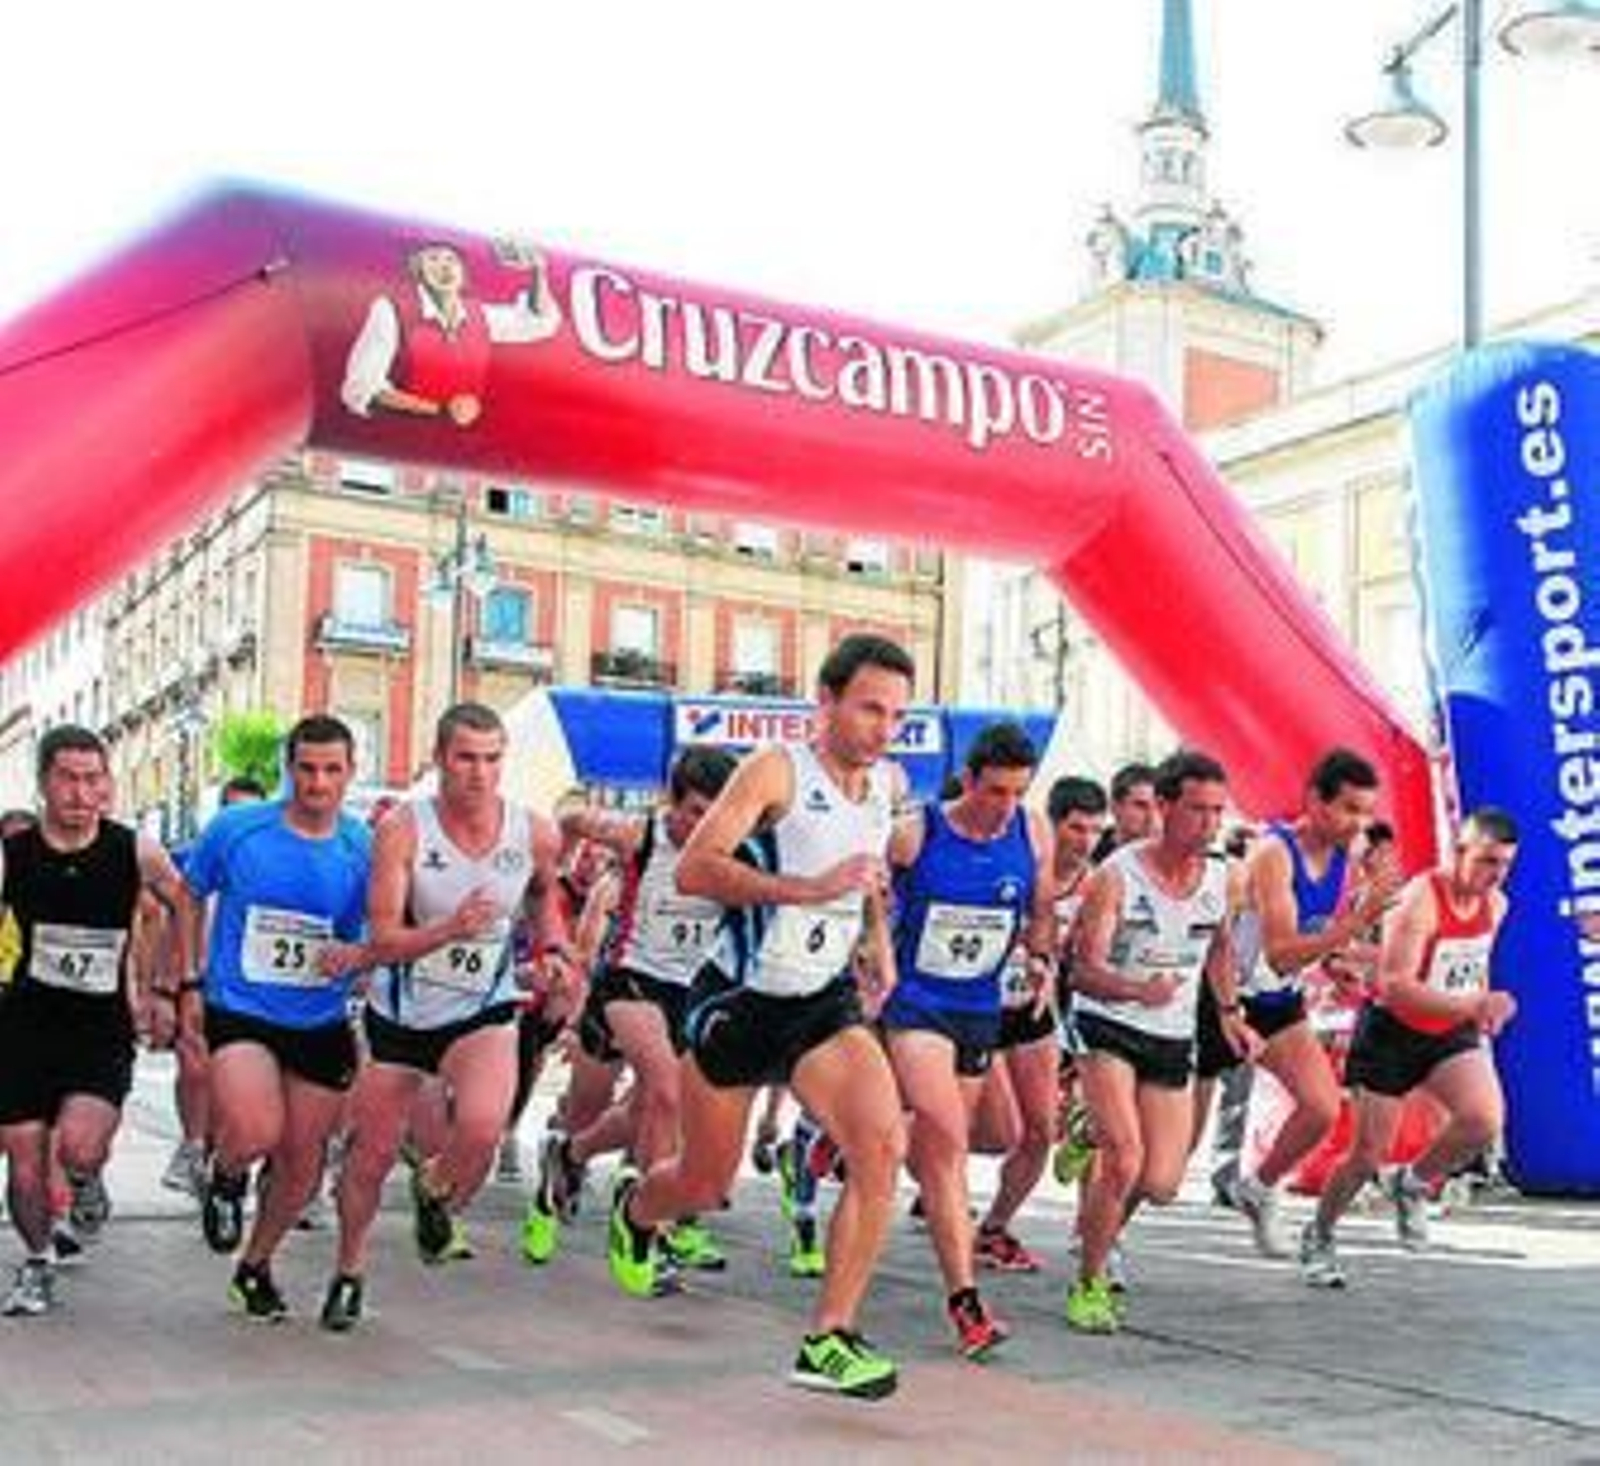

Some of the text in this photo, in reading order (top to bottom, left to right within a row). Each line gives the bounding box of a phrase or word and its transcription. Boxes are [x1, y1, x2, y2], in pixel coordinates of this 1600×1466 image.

[568, 268, 1064, 449] Cruzcampo
[1077, 387, 1111, 463] SIN
[806, 919, 826, 954] 6
[59, 952, 94, 978] 67
[272, 940, 306, 968] 25
[447, 948, 482, 974] 96
